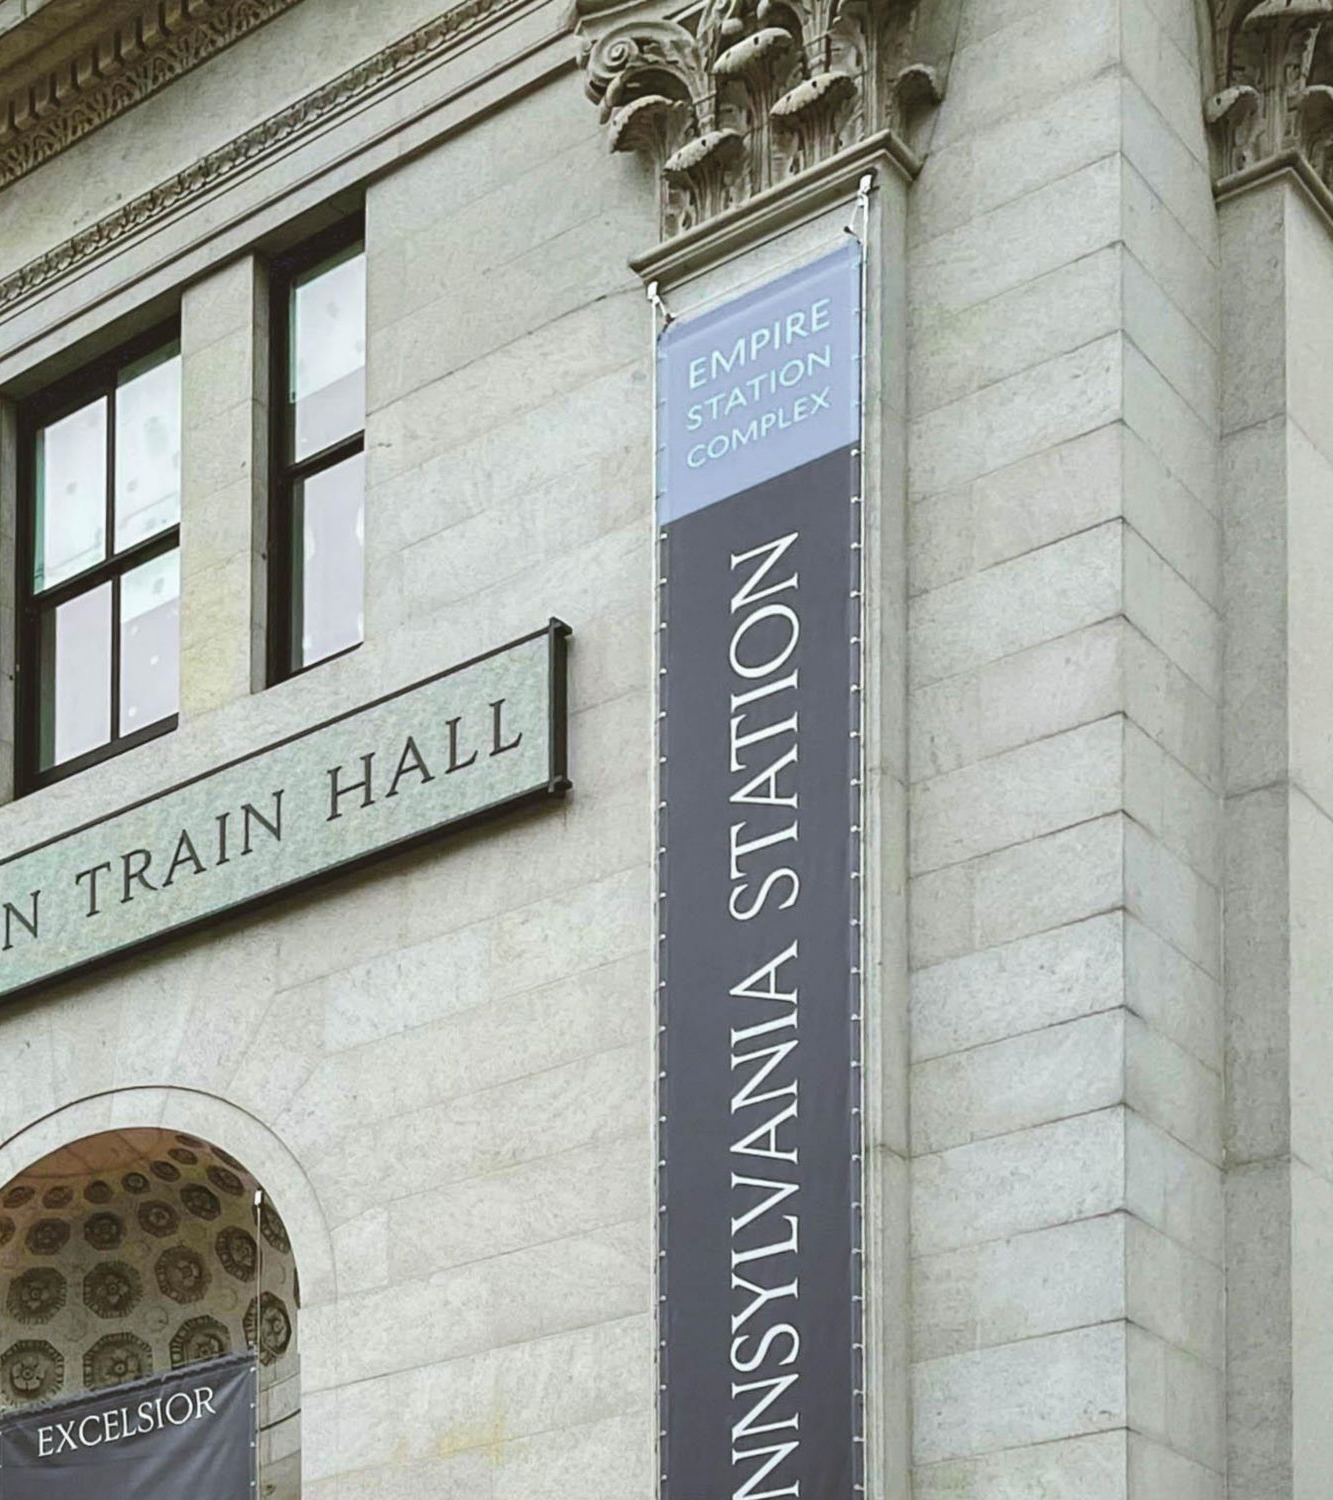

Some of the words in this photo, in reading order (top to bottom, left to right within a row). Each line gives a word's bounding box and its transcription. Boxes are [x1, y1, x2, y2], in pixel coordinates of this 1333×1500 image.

[687, 345, 832, 430] STATION
[689, 298, 831, 389] EMPIRE
[687, 387, 831, 468] COMPLEX
[728, 531, 800, 922] STATION
[75, 788, 285, 918] TRAIN
[326, 698, 524, 823] HALL
[37, 1386, 217, 1458] EXCELSIOR
